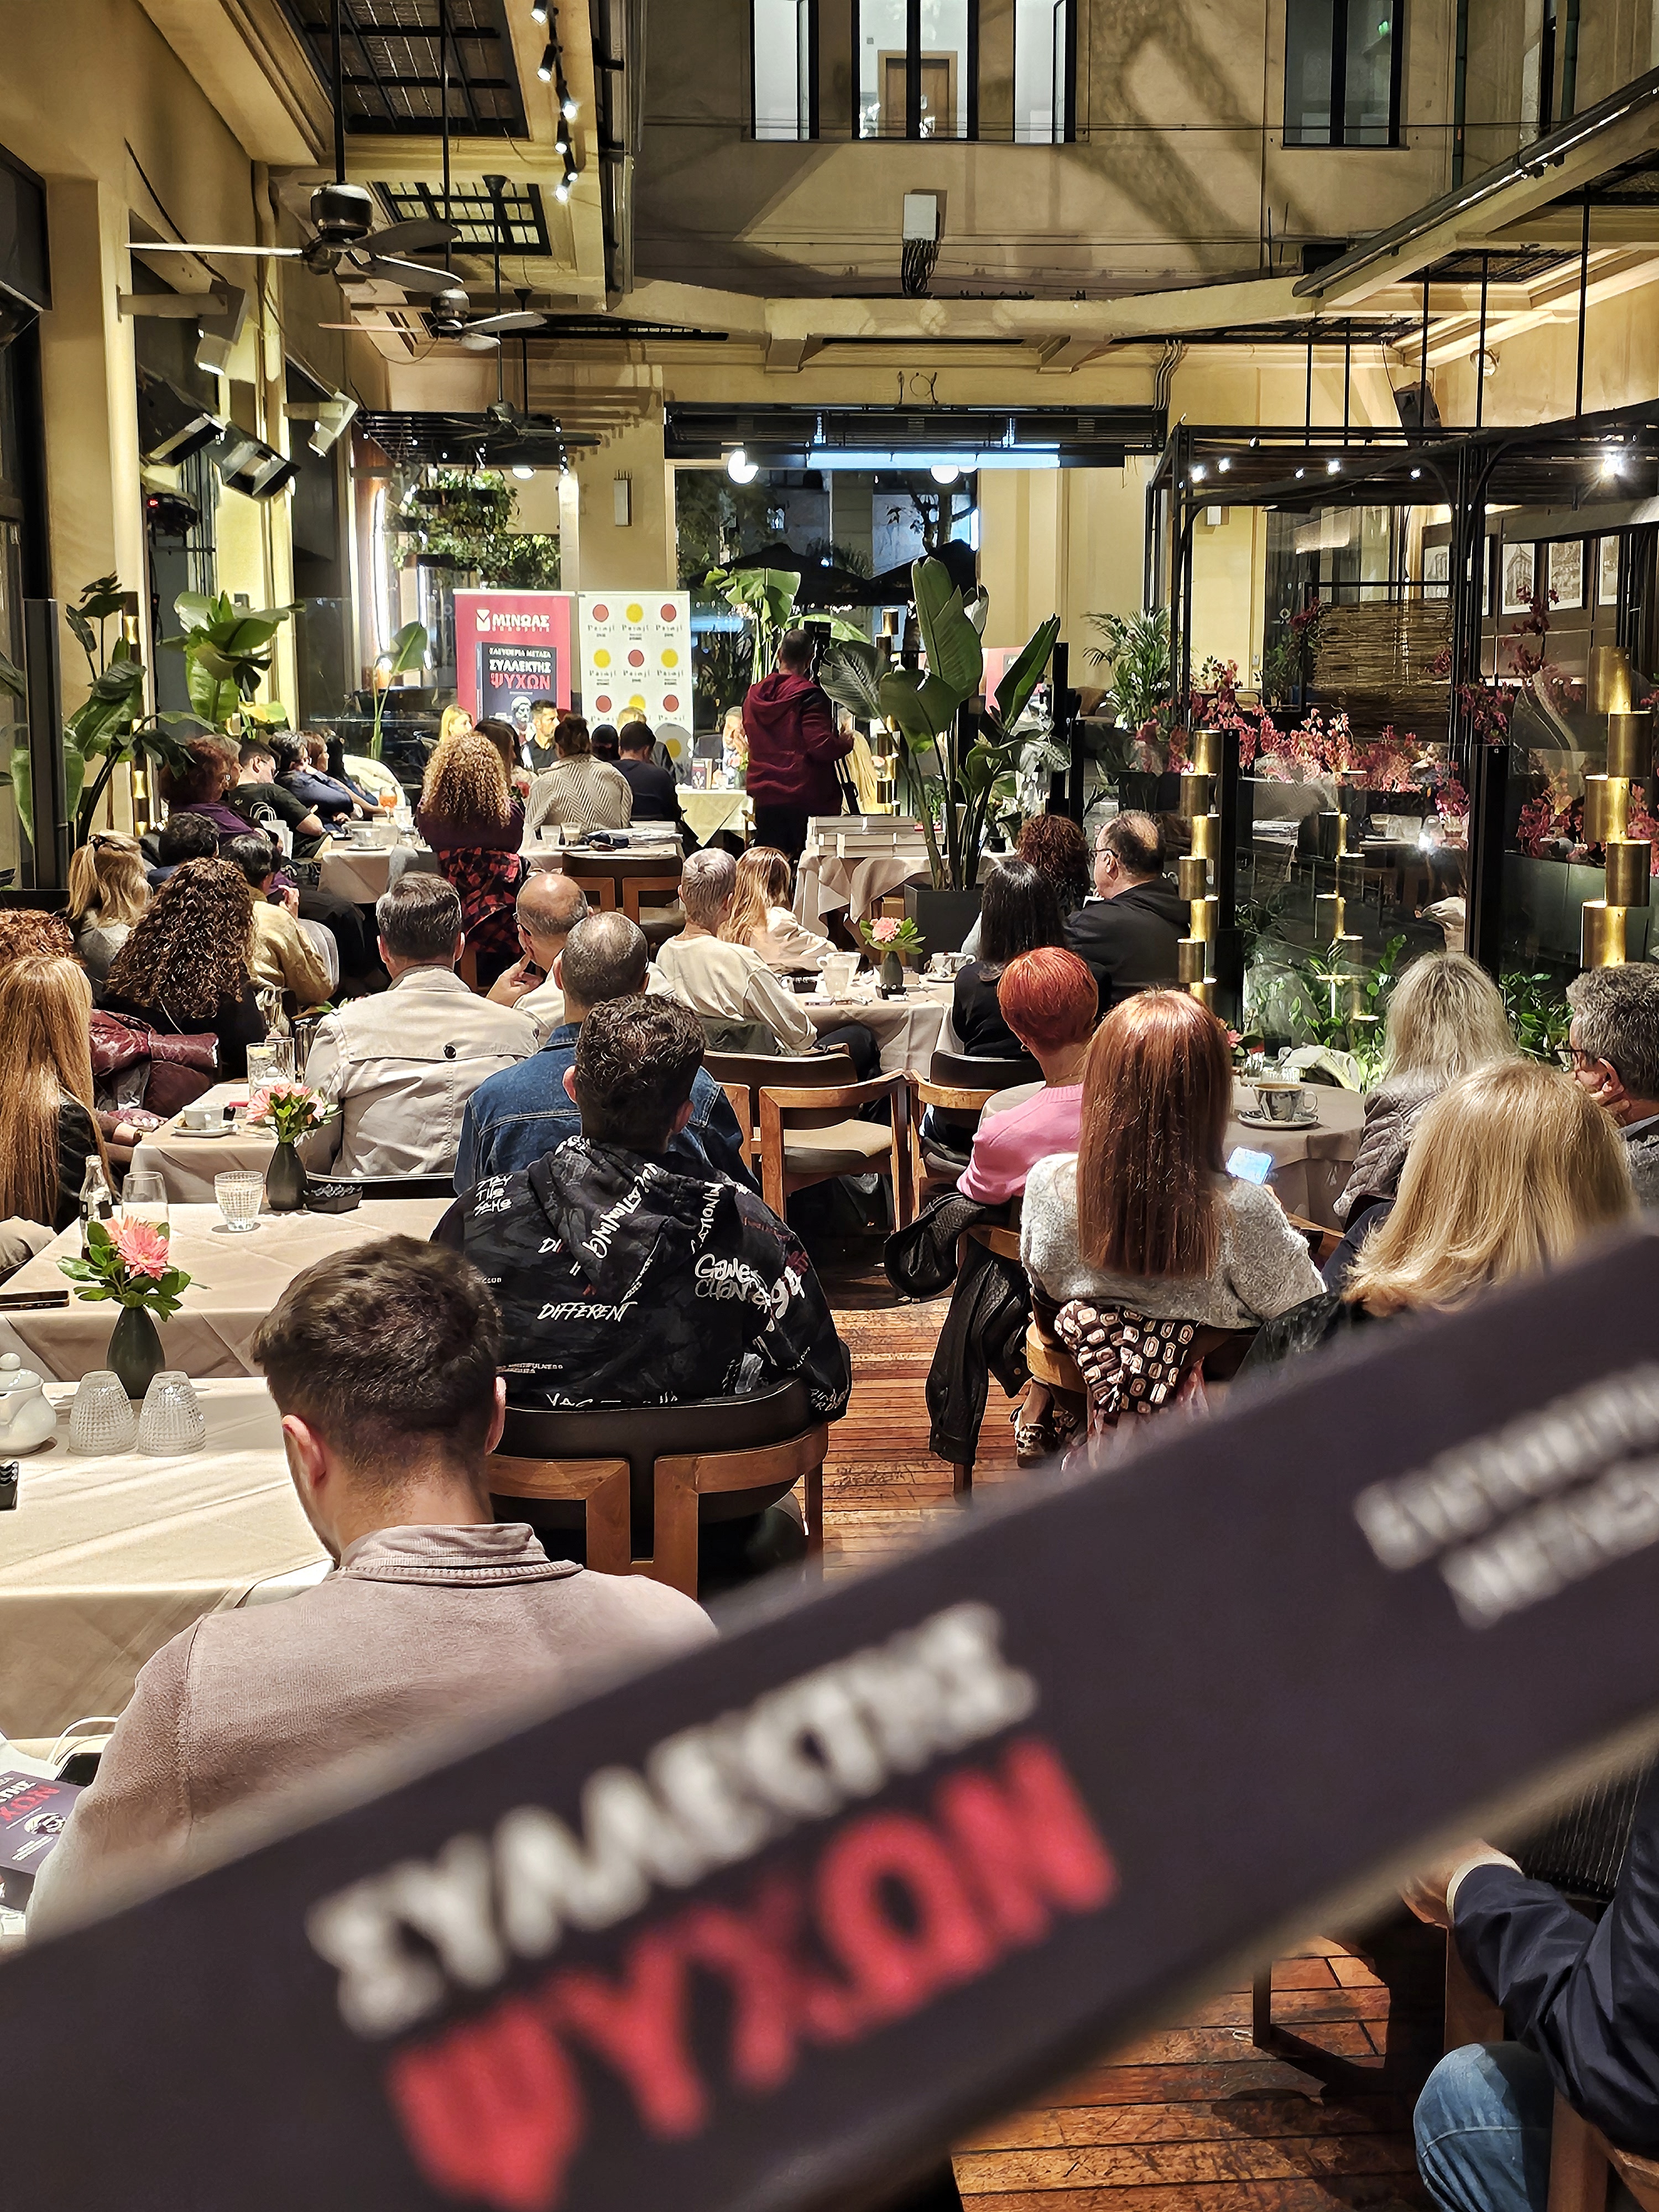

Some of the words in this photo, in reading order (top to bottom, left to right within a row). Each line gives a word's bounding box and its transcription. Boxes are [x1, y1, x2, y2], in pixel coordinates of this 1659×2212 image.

[492, 614, 550, 627] ΜΙΝΩΑΣ
[489, 659, 551, 673] ΣΥΛΛΕΚΤΗΣ
[491, 673, 550, 690] ΨΥΧΩΝ
[536, 1301, 638, 1323] DIFFERENT
[388, 1738, 1117, 2212] ΨΥΧΩΝ
